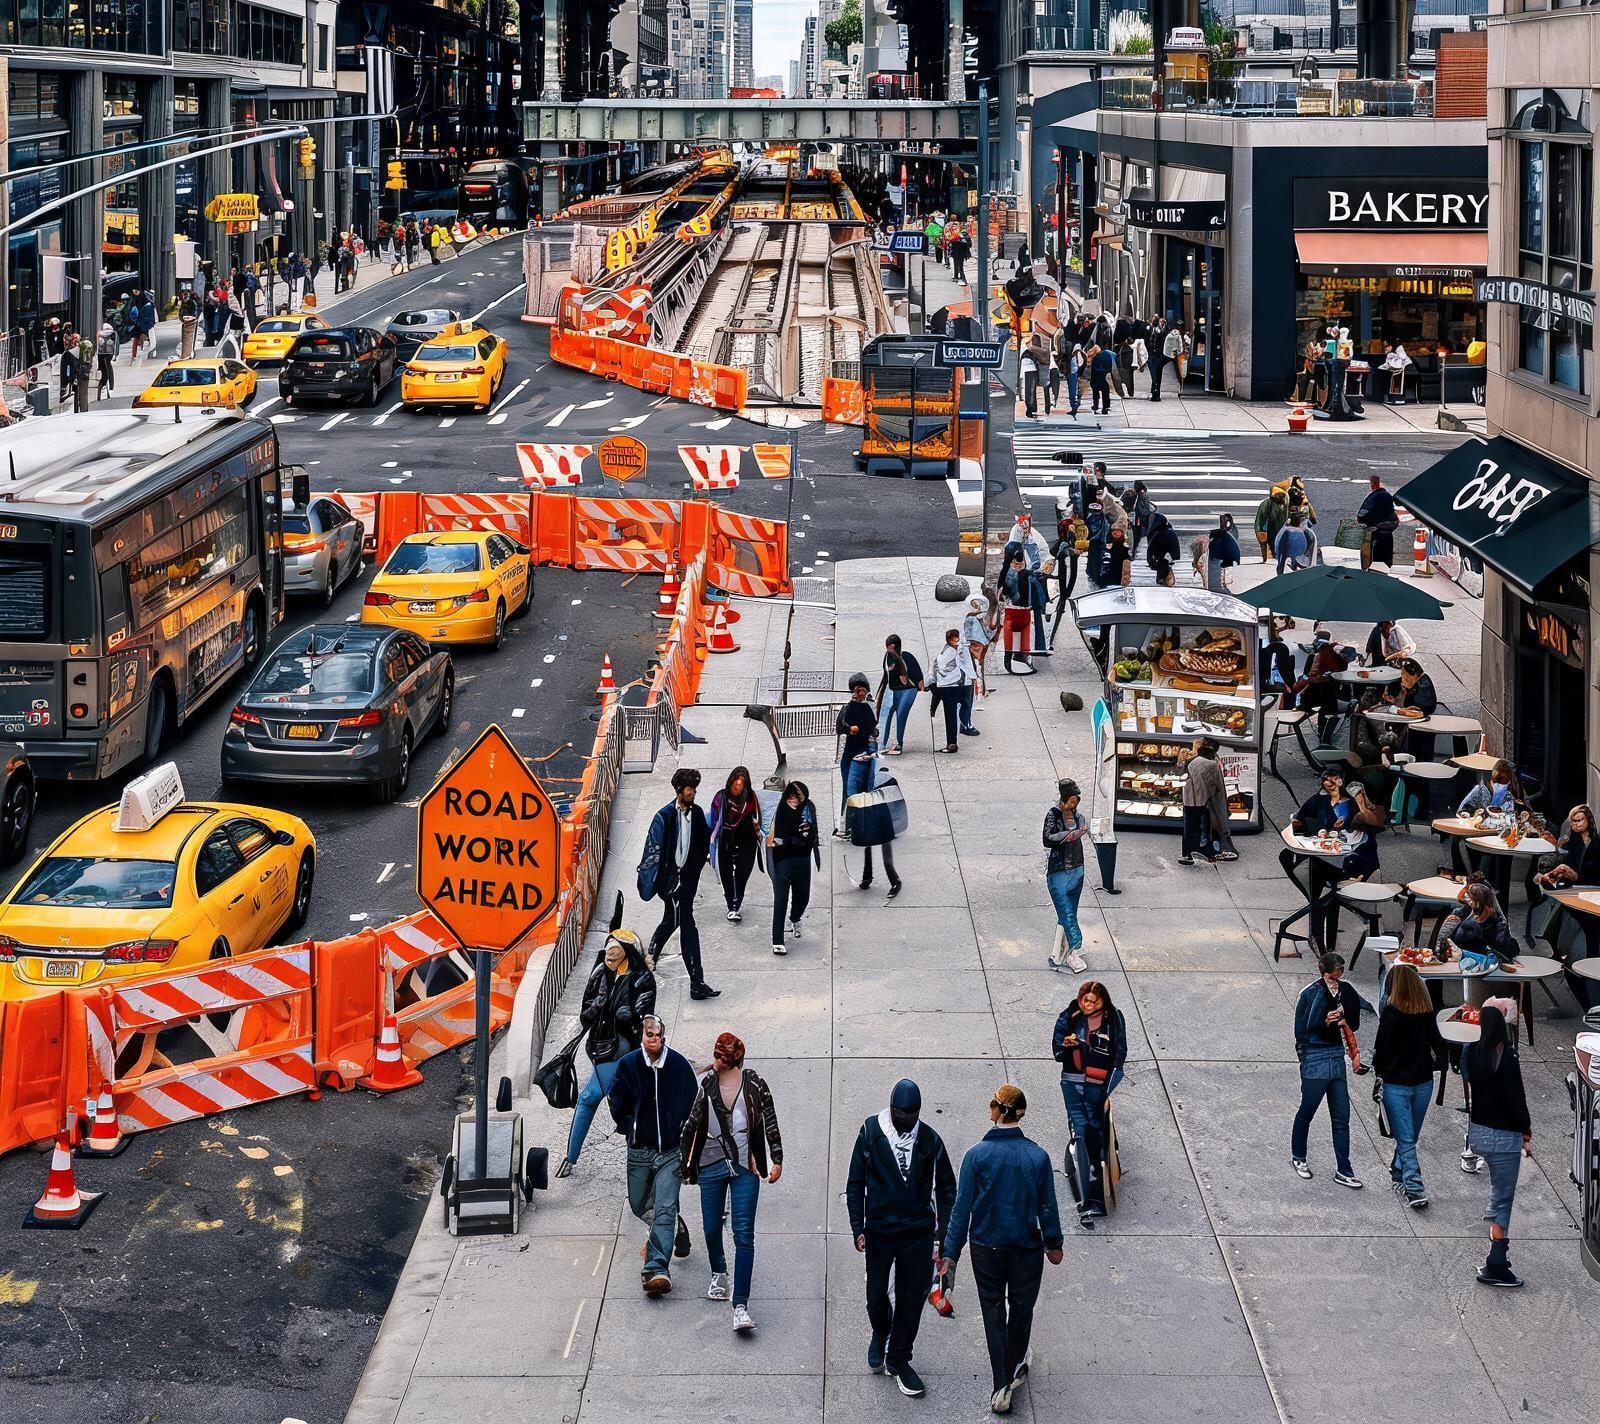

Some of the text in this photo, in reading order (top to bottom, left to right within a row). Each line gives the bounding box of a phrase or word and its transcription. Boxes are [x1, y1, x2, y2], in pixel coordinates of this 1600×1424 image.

[1328, 191, 1488, 224] BAKERY
[445, 787, 543, 821] ROAD
[434, 832, 541, 869] WORK
[433, 876, 543, 911] AHEAD
